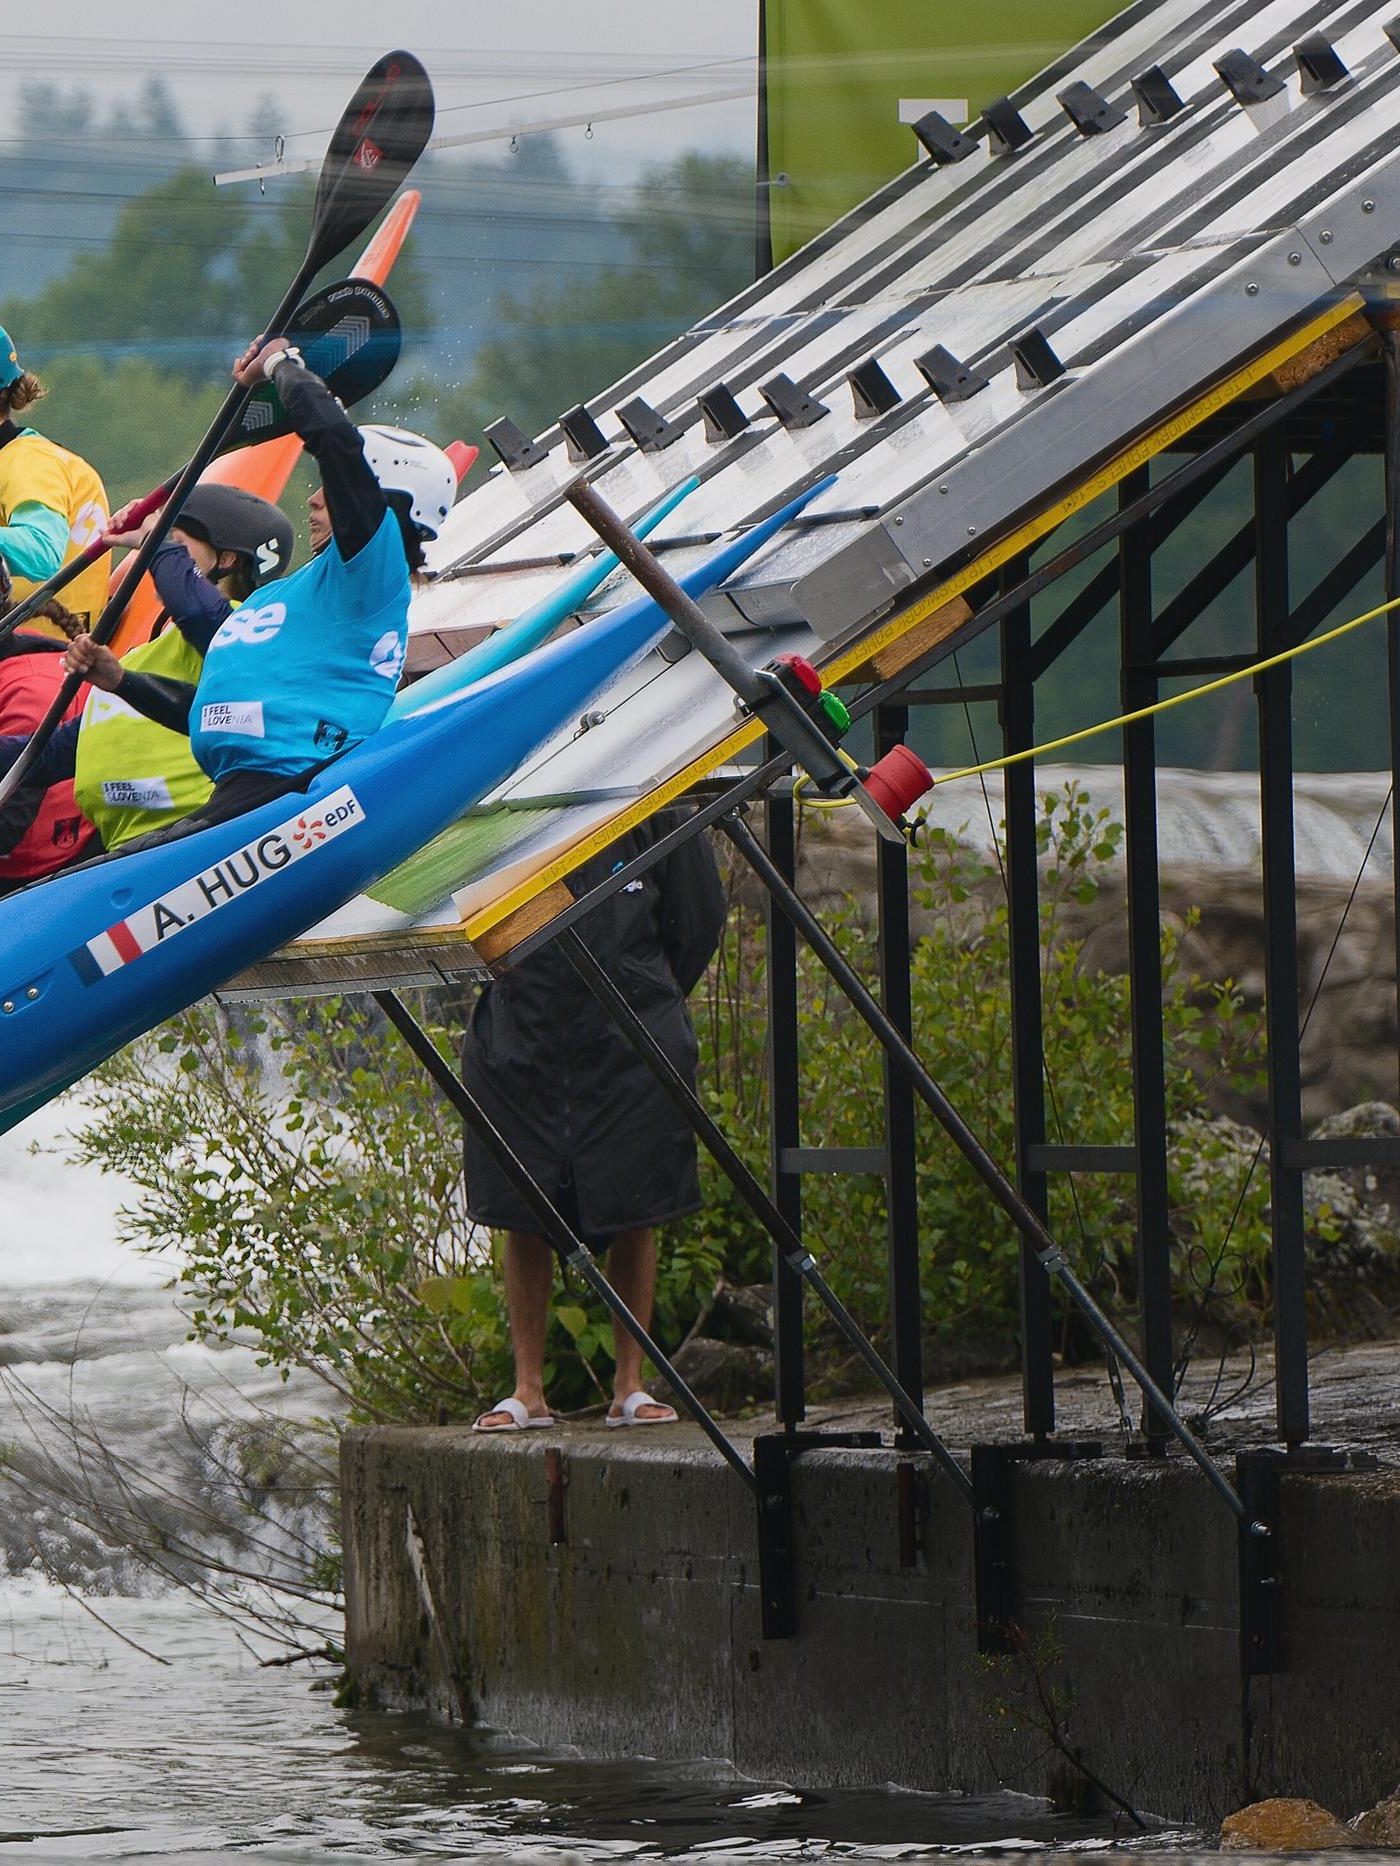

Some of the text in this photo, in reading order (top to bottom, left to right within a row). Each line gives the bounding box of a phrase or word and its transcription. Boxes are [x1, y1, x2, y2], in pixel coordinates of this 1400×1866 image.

[203, 704, 232, 718] I FEEL
[110, 781, 136, 792] FEEL
[153, 902, 195, 940] A.
[196, 834, 292, 908] HUG
